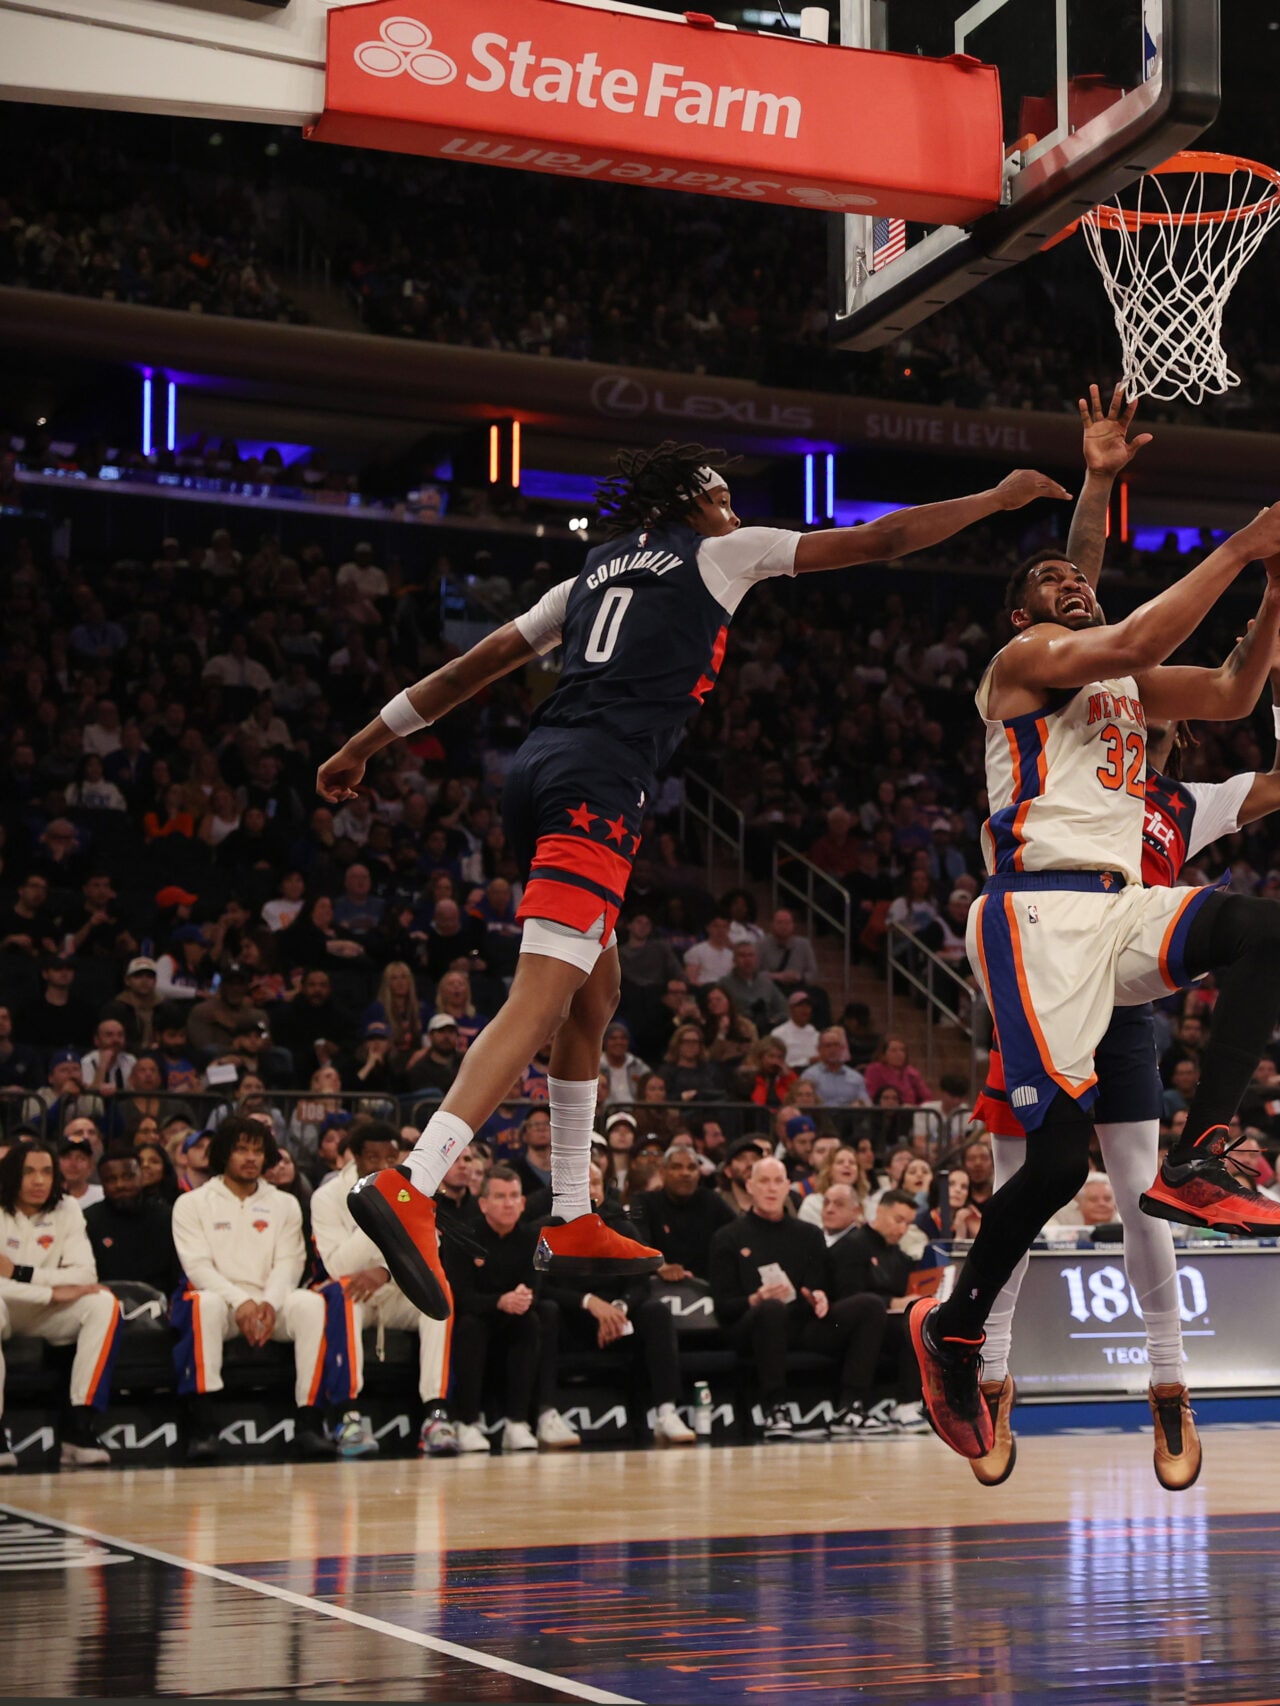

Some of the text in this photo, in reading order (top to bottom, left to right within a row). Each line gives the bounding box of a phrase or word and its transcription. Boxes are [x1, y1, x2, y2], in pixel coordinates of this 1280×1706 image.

[654, 391, 815, 430] LEXUS
[864, 412, 1033, 452] SUITE LEVEL
[585, 550, 684, 591] COULIBALY
[584, 586, 634, 664] 0
[1096, 722, 1146, 801] 32
[1060, 1264, 1209, 1324] 180
